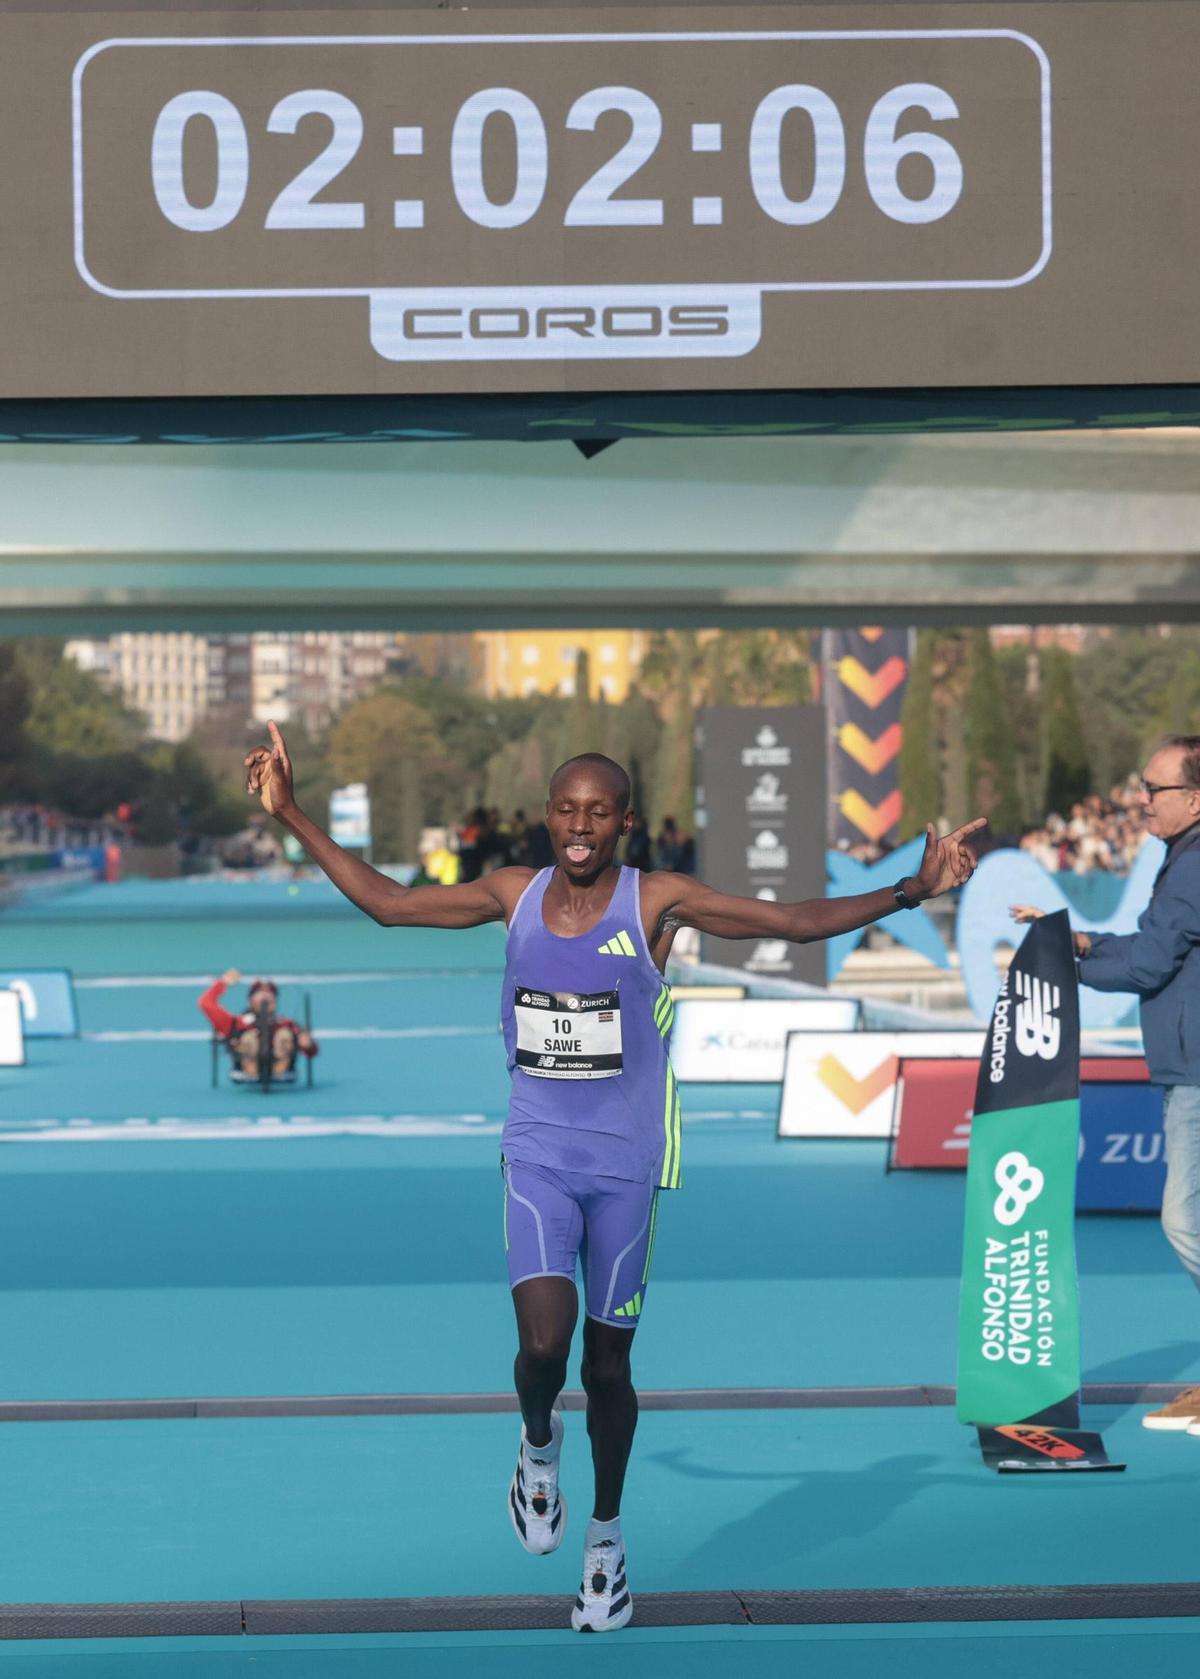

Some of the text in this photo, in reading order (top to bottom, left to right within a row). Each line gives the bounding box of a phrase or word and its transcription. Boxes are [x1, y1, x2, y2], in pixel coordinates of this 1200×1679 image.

[150, 83, 965, 232] 02:02:06
[401, 305, 729, 340] COROS
[581, 998, 610, 1008] ZURICH
[552, 1018, 572, 1035] 10
[990, 999, 1012, 1084] balance
[544, 1038, 583, 1053] SAWE
[568, 1061, 593, 1069] balance
[1101, 1133, 1167, 1163] ZU
[981, 1237, 1008, 1361] ALFONSO
[1008, 1230, 1033, 1366] TRINIDAD
[1034, 1229, 1056, 1367] FUNDACIÓN
[1014, 1428, 1067, 1452] 42K
